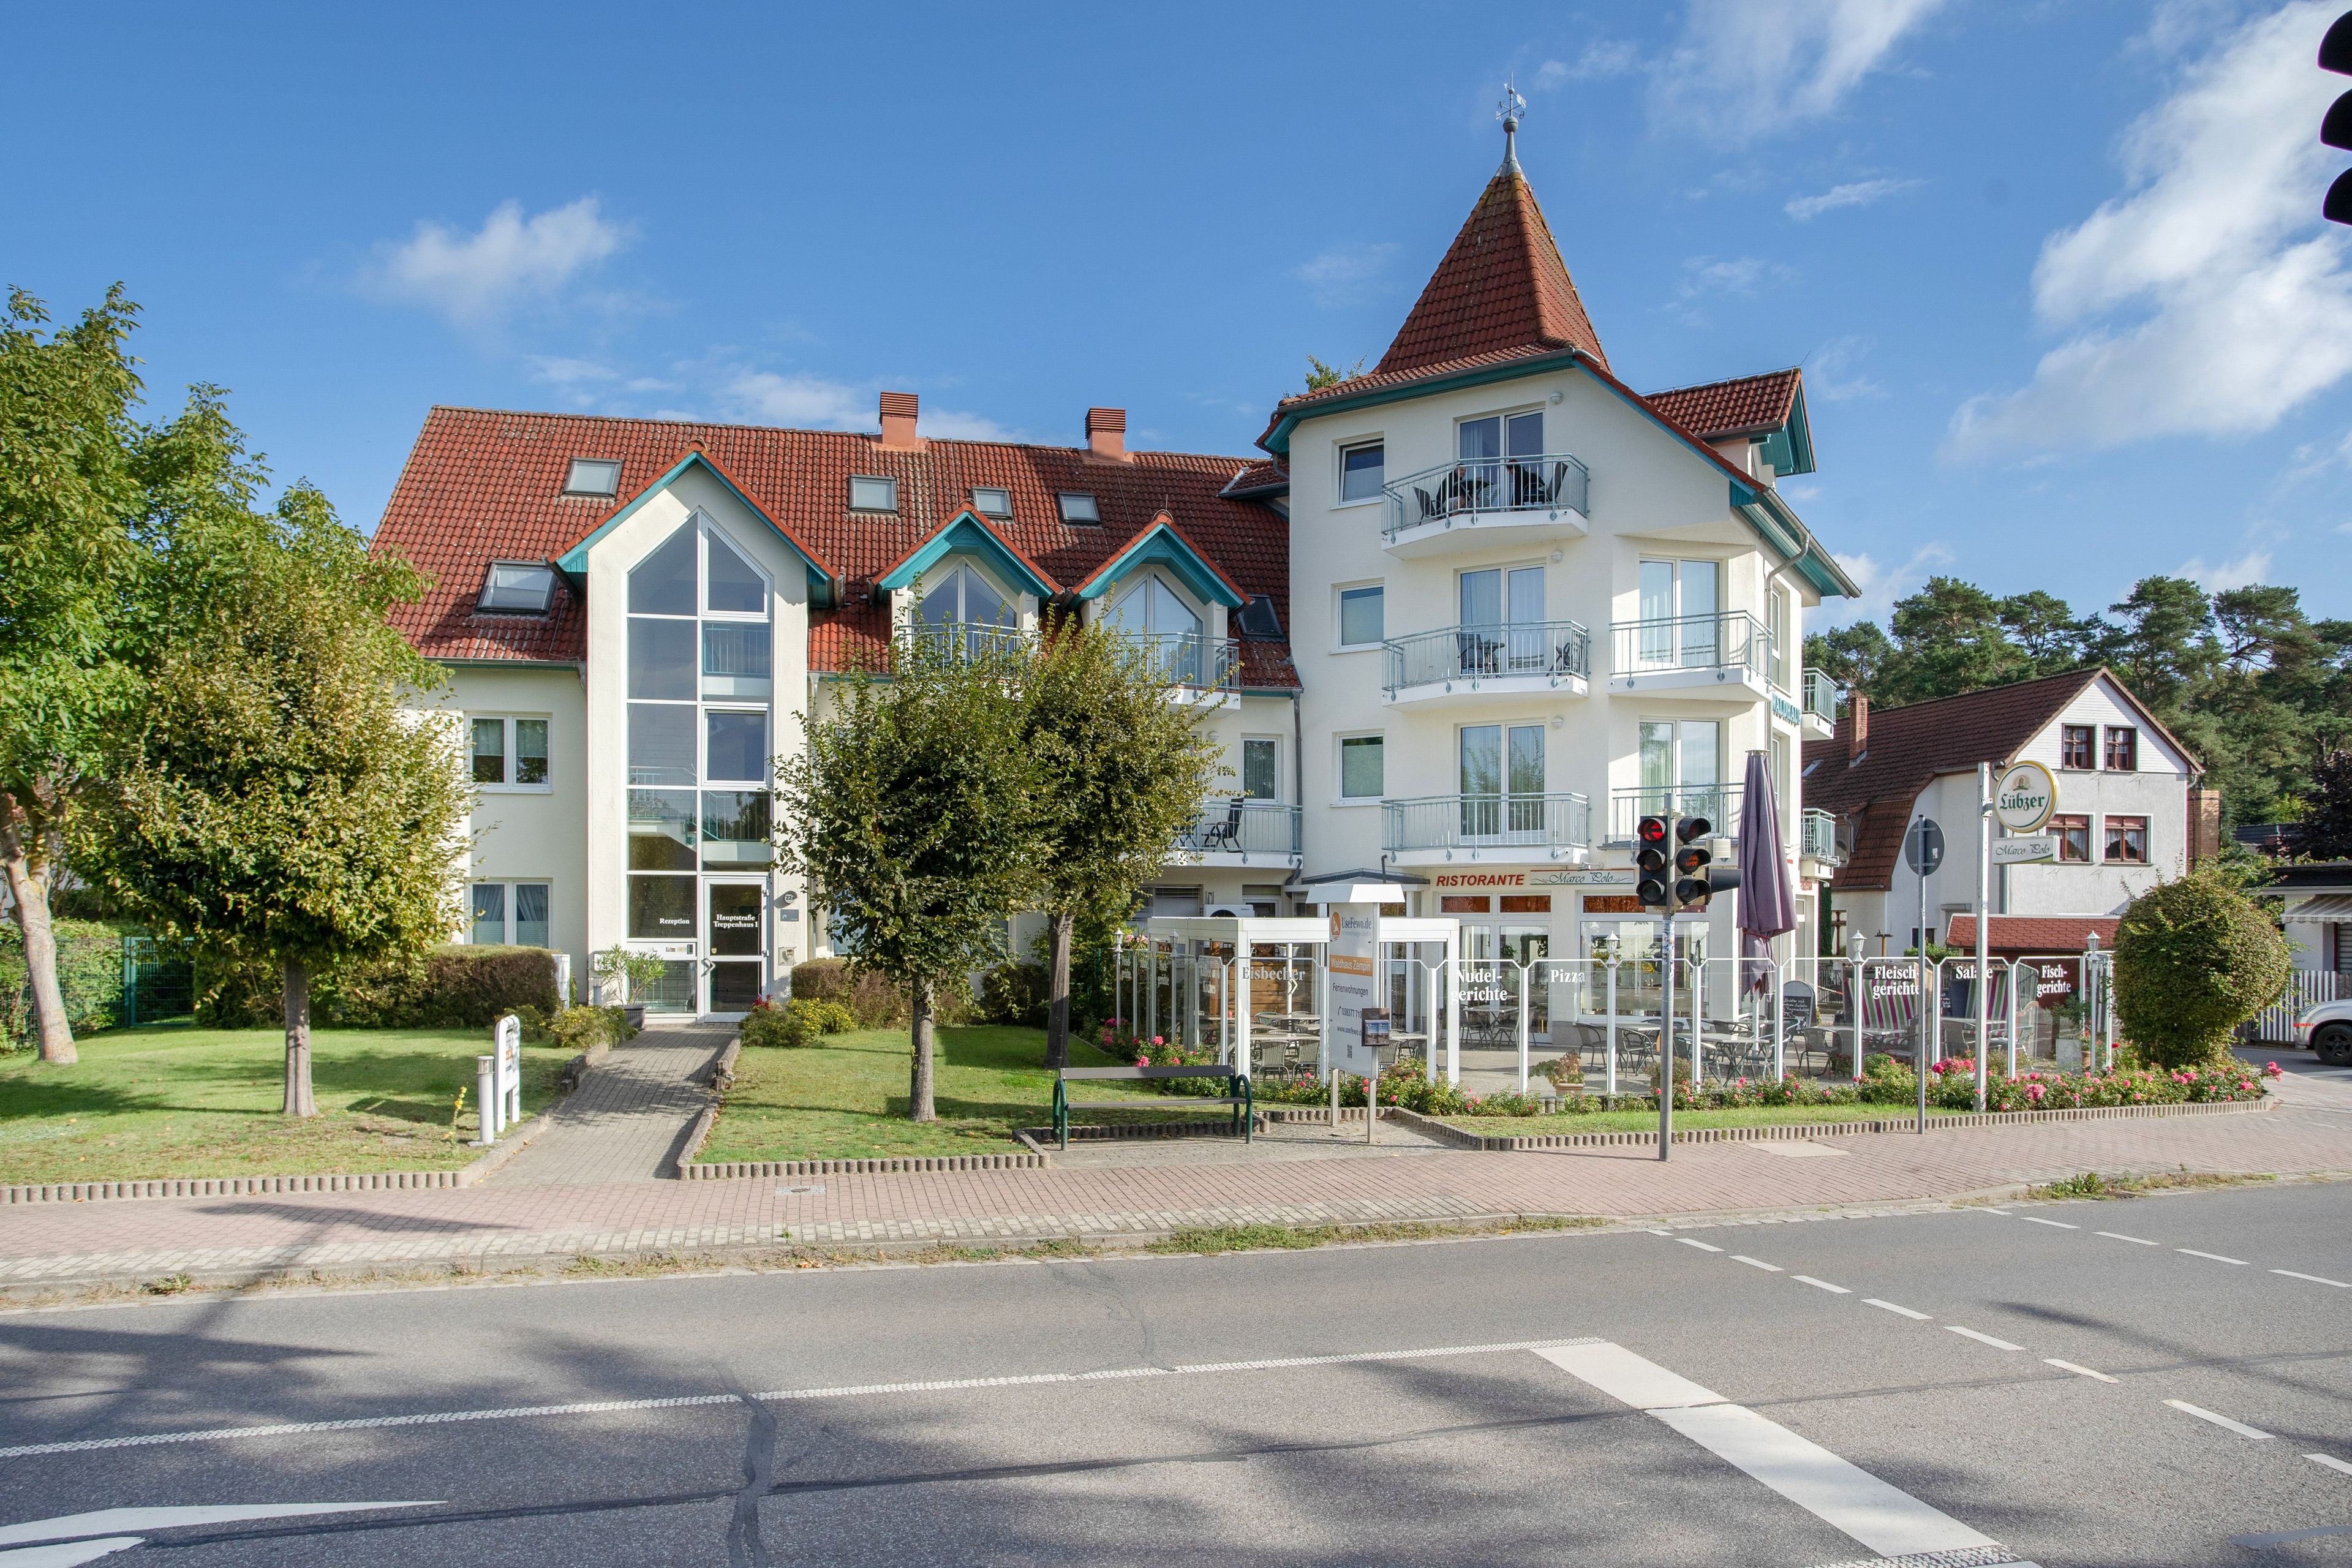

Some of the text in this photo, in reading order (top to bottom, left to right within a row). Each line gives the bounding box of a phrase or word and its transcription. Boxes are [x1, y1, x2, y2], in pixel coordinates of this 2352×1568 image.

[1999, 793, 2045, 812] Lübzer
[1995, 843, 2050, 856] Marco Polo
[1436, 874, 1525, 886] RISTORANTE
[1549, 871, 1613, 883] Marco Polo
[1341, 917, 1371, 929] UseFewo.de
[1330, 958, 1371, 973] Waldhaus Zempin
[1956, 965, 1992, 979] Sale
[2041, 964, 2067, 978] Fisch-
[1242, 966, 1305, 981] Eisbecher
[1456, 968, 1502, 983] Nudel-
[1550, 968, 1585, 984] Pizza
[1332, 982, 1368, 997] Ferienwohnungen
[1450, 986, 1508, 1005] gerichte
[1872, 981, 1920, 999] gerichte
[2037, 979, 2071, 997] gerichte
[1336, 1025, 1362, 1036] www.usefewo.d
